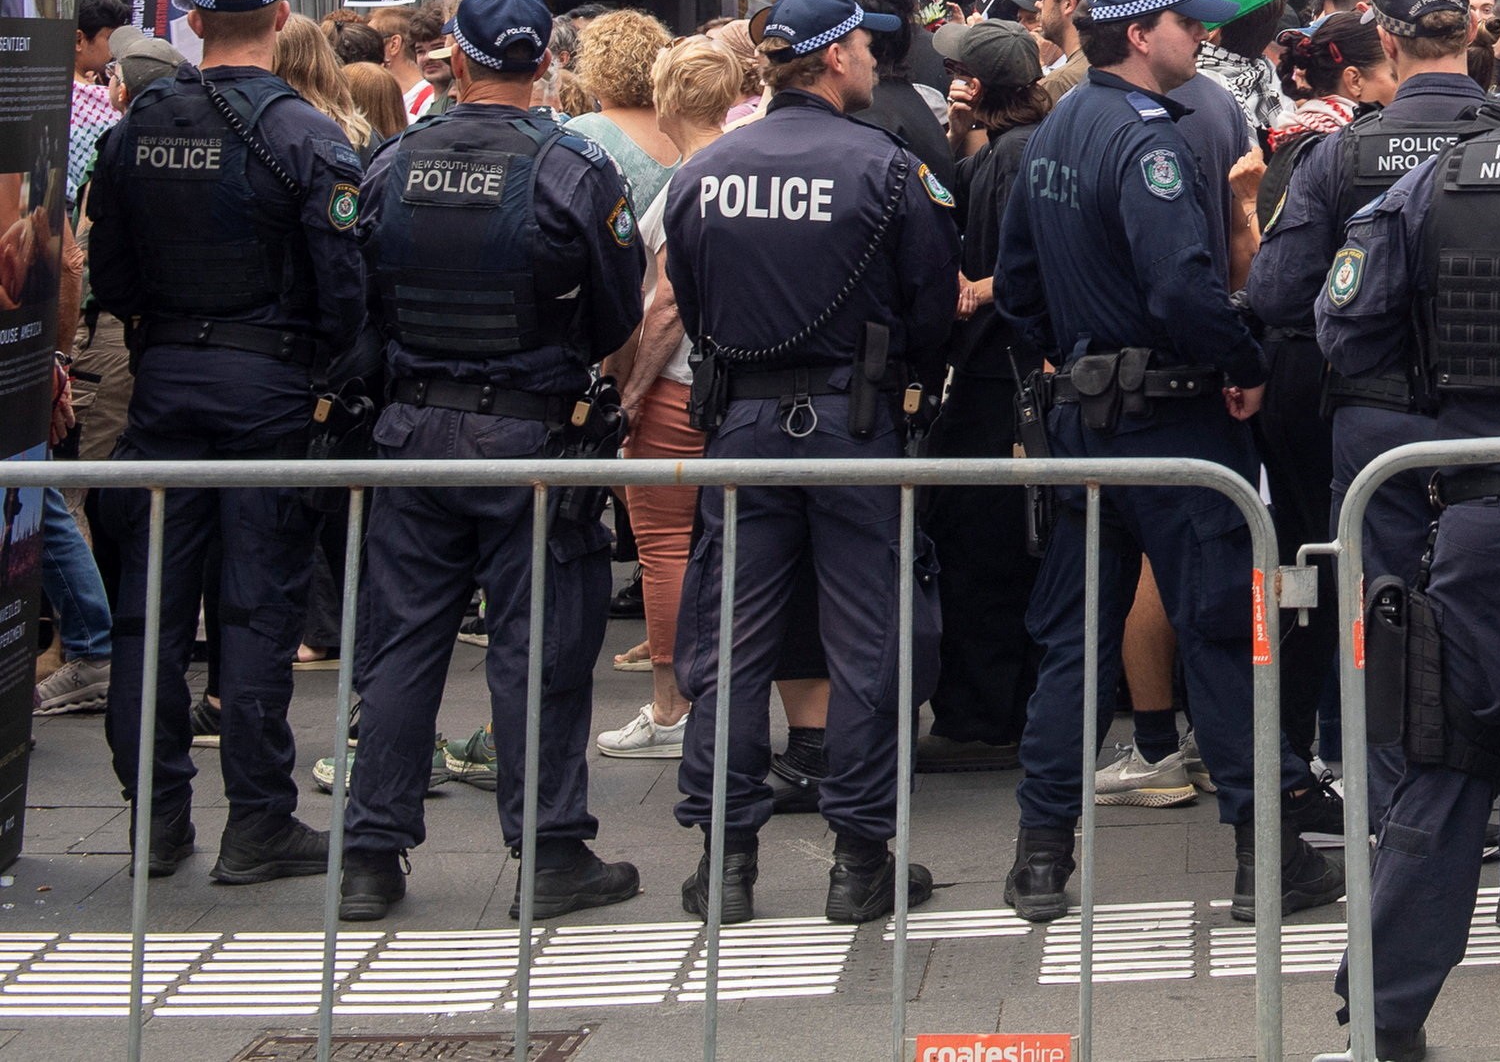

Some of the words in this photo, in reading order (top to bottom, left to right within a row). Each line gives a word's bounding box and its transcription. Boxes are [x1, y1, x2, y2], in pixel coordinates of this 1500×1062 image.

[1408, 0, 1423, 15] NSW
[506, 26, 531, 35] POLICE
[778, 24, 796, 36] FORCE
[137, 136, 157, 145] NEW
[158, 136, 190, 146] SOUTH
[191, 138, 222, 147] WALES
[1388, 136, 1458, 153] POLICE
[136, 145, 221, 169] POLICE
[1378, 155, 1419, 170] NRO
[411, 160, 433, 169] NEW
[434, 160, 468, 170] SOUTH
[470, 162, 503, 174] WALES
[406, 169, 502, 196] POLICE
[700, 174, 835, 222] POLICE
